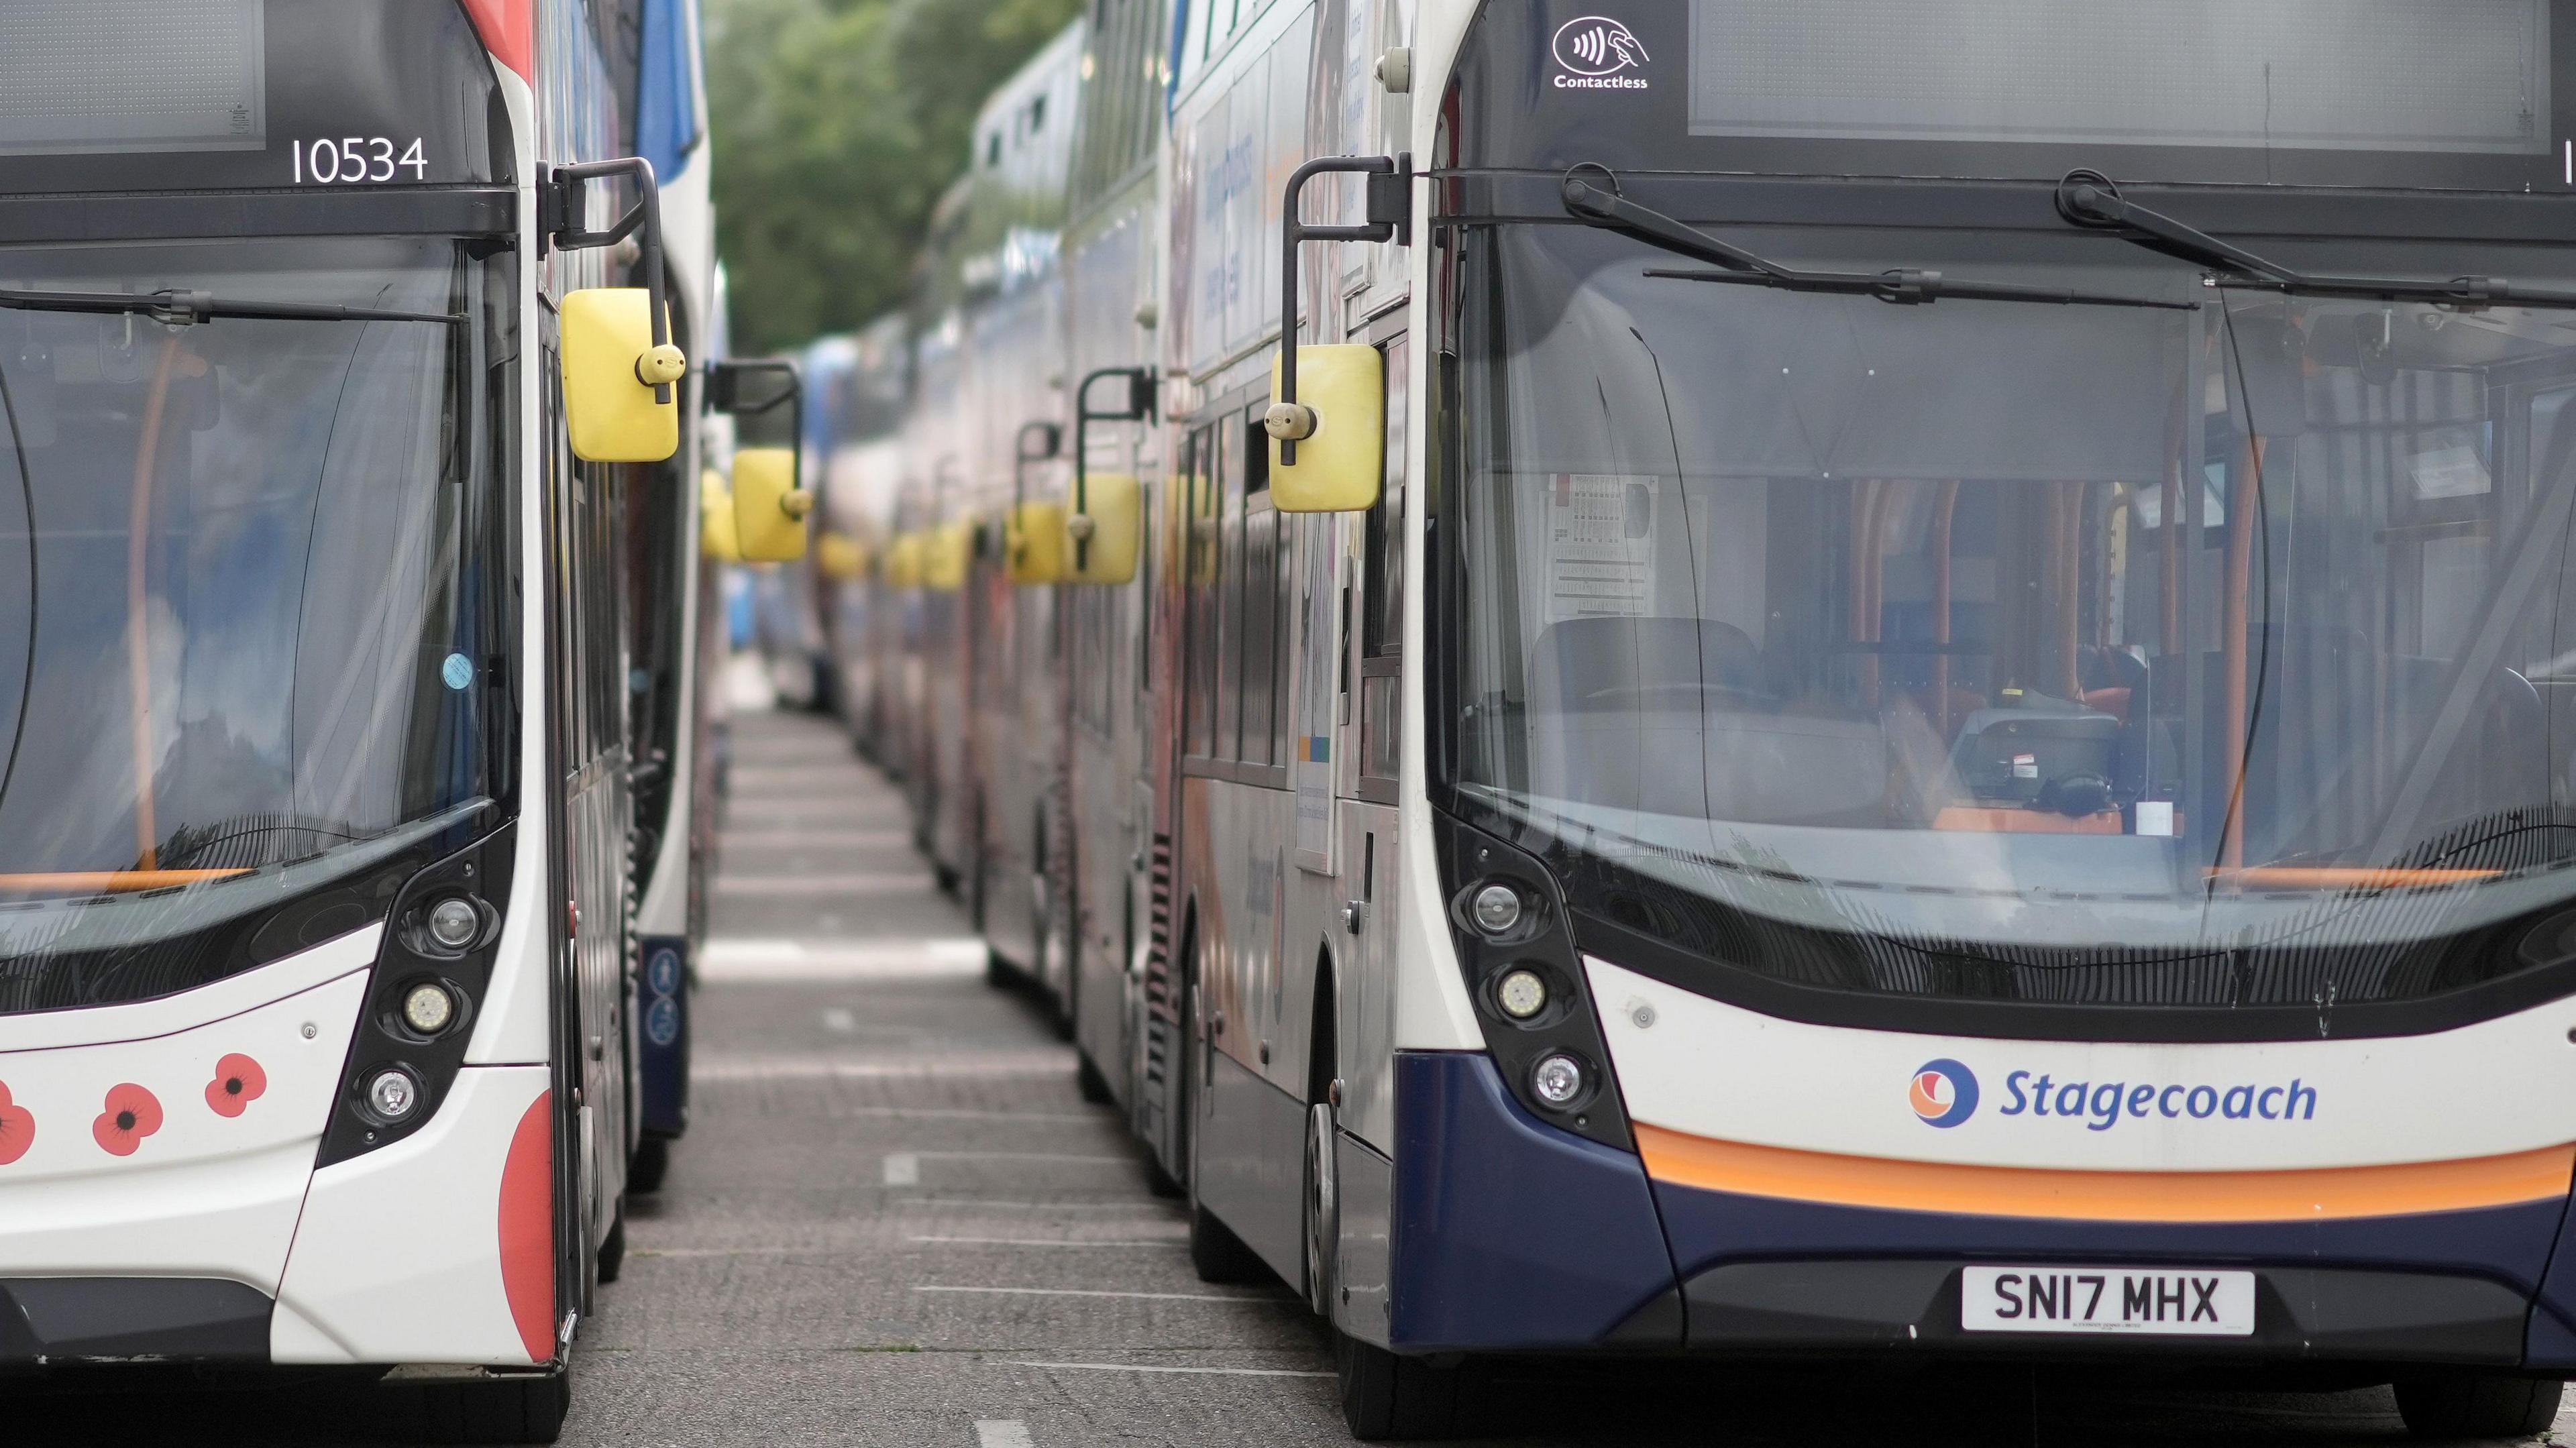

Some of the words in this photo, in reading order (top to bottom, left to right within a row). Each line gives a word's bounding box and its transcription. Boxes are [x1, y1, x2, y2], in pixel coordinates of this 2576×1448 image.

[1554, 74, 1648, 89] Contactless
[294, 137, 428, 183] 10534
[2000, 1070, 2317, 1131] Stagecoach
[1994, 1274, 2106, 1321] SN17
[2123, 1276, 2219, 1323] MHX
